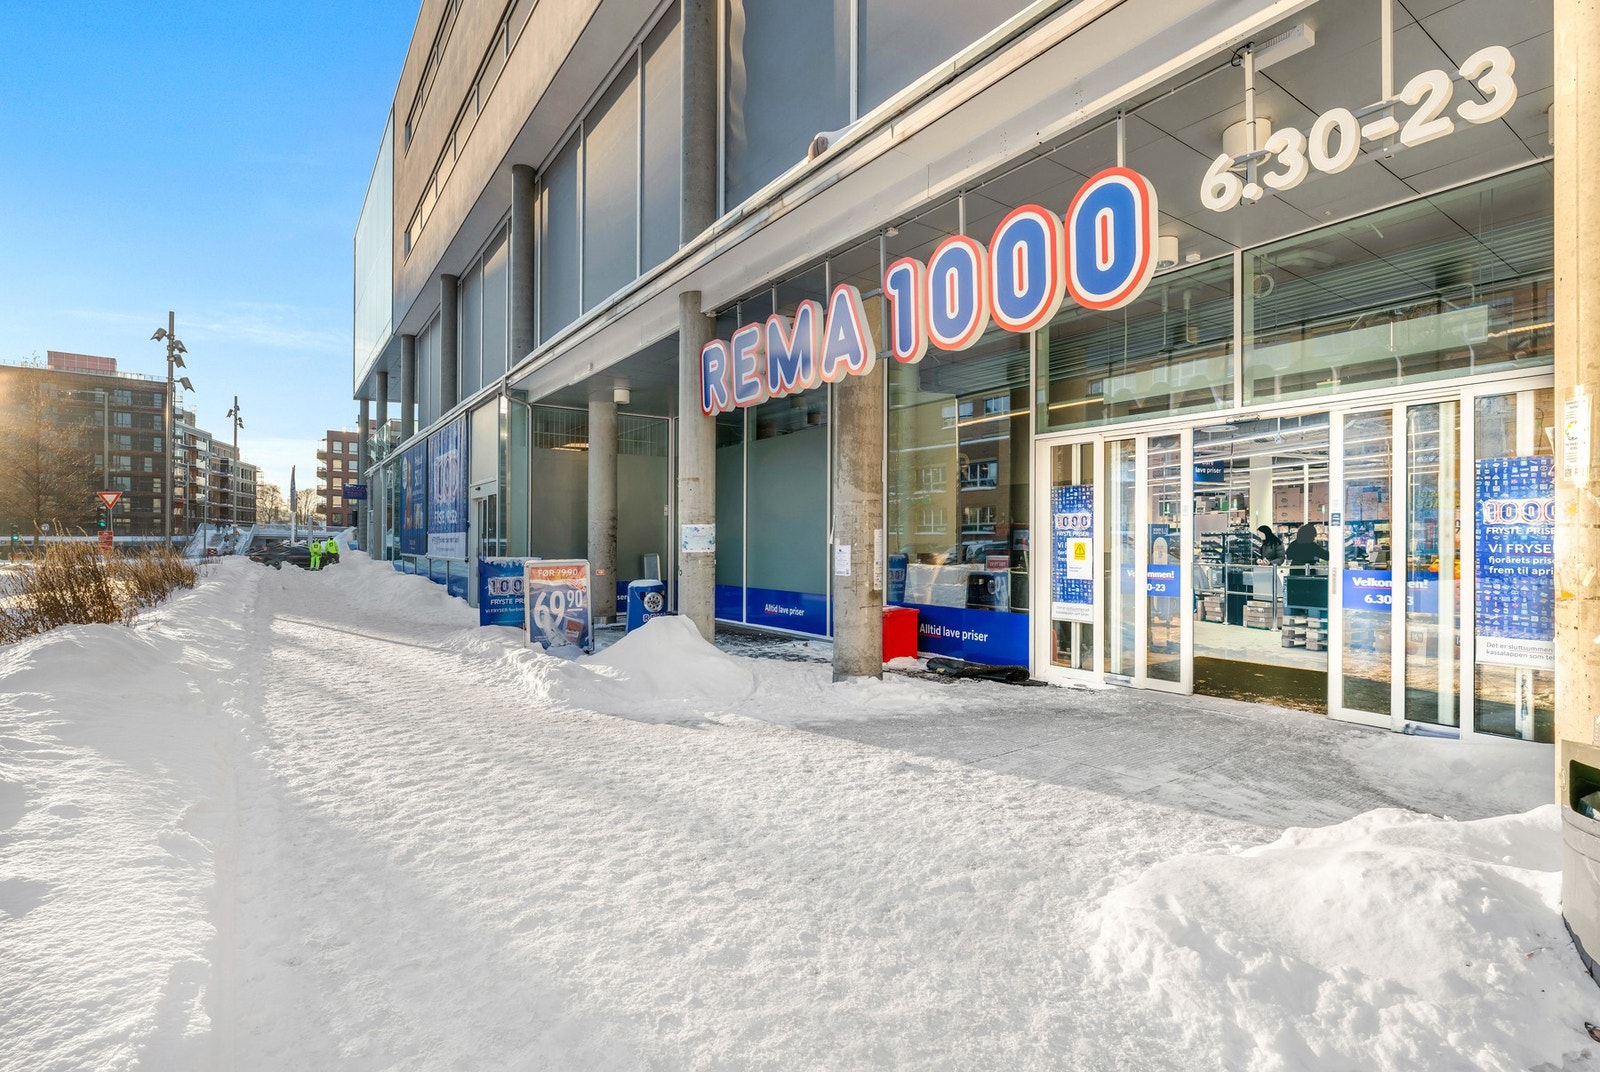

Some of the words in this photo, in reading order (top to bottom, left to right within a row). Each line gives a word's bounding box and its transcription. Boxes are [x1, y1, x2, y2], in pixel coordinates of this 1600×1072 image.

[1200, 46, 1518, 213] 6.30-23
[701, 283, 875, 416] REMA
[884, 167, 1158, 365] 1000
[1195, 466, 1206, 474] lave
[1206, 467, 1222, 475] priser
[1484, 501, 1555, 524] 1000
[1486, 527, 1522, 535] FRYSTE
[1488, 543, 1503, 554] Vi
[1506, 543, 1555, 554] FRYSE
[1488, 556, 1531, 565] fjorårets
[537, 569, 555, 577] FØR
[1488, 565, 1515, 575] frem
[1516, 565, 1529, 575] til
[534, 590, 566, 629] 69
[567, 589, 583, 608] 90
[765, 603, 778, 613] Alltid
[778, 606, 789, 615] lave
[789, 607, 805, 617] priser
[919, 623, 941, 636] Alltid
[942, 626, 960, 640] lave
[961, 628, 988, 643] priser
[1508, 644, 1553, 653] sluttsummen
[1486, 649, 1528, 659] kassalappen
